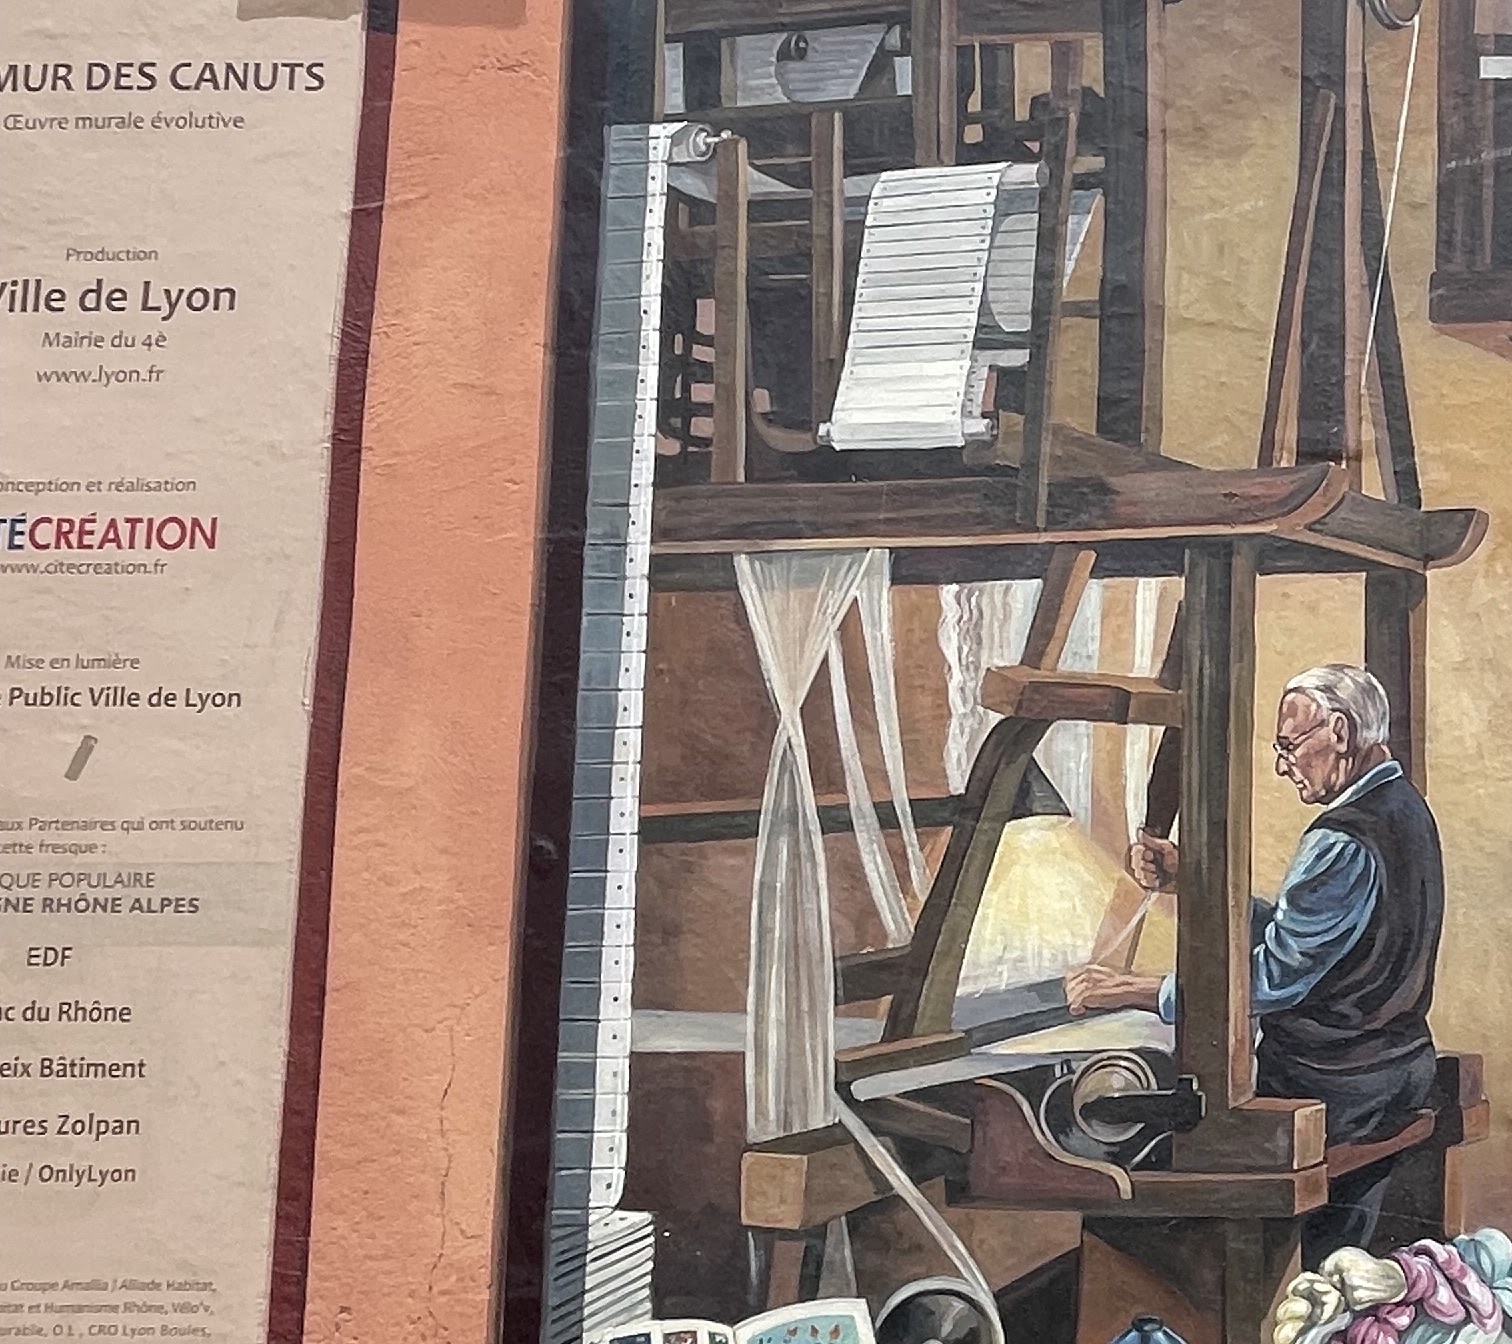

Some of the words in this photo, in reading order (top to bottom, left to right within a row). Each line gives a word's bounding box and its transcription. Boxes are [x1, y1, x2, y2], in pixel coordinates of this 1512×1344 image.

[0, 63, 75, 93] MUR
[86, 62, 158, 91] DES
[169, 62, 325, 92] CANUTS
[74, 111, 145, 130] murale
[150, 110, 245, 130] évolutive
[65, 246, 159, 262] Production
[78, 278, 128, 312] de
[140, 280, 236, 322] Lyon
[41, 330, 105, 349] Mairie
[110, 330, 136, 348] du
[36, 364, 165, 388] www.lyon.fr
[85, 480, 103, 493] et
[106, 476, 197, 493] réalisation
[4, 654, 46, 670] Mise
[48, 657, 71, 670] en
[75, 652, 141, 670] lumière
[8, 685, 82, 708] Public
[88, 686, 141, 708] Ville
[147, 686, 178, 708] de
[184, 687, 242, 714] Lyon
[28, 817, 117, 832] Partenaires
[120, 817, 145, 835] qui
[148, 818, 177, 831] ont
[179, 818, 245, 832] soutenu
[38, 838, 99, 856] fresque
[47, 871, 156, 889] POPULAIRE
[41, 892, 123, 914] RHÔNE
[128, 897, 200, 914] ALPES
[26, 946, 73, 967] EDF
[21, 999, 50, 1023] du
[57, 999, 132, 1023] Rhône
[39, 1055, 147, 1079] Bâtiment
[55, 1112, 140, 1142] Zolpan
[38, 1163, 136, 1188] OnlyLyon
